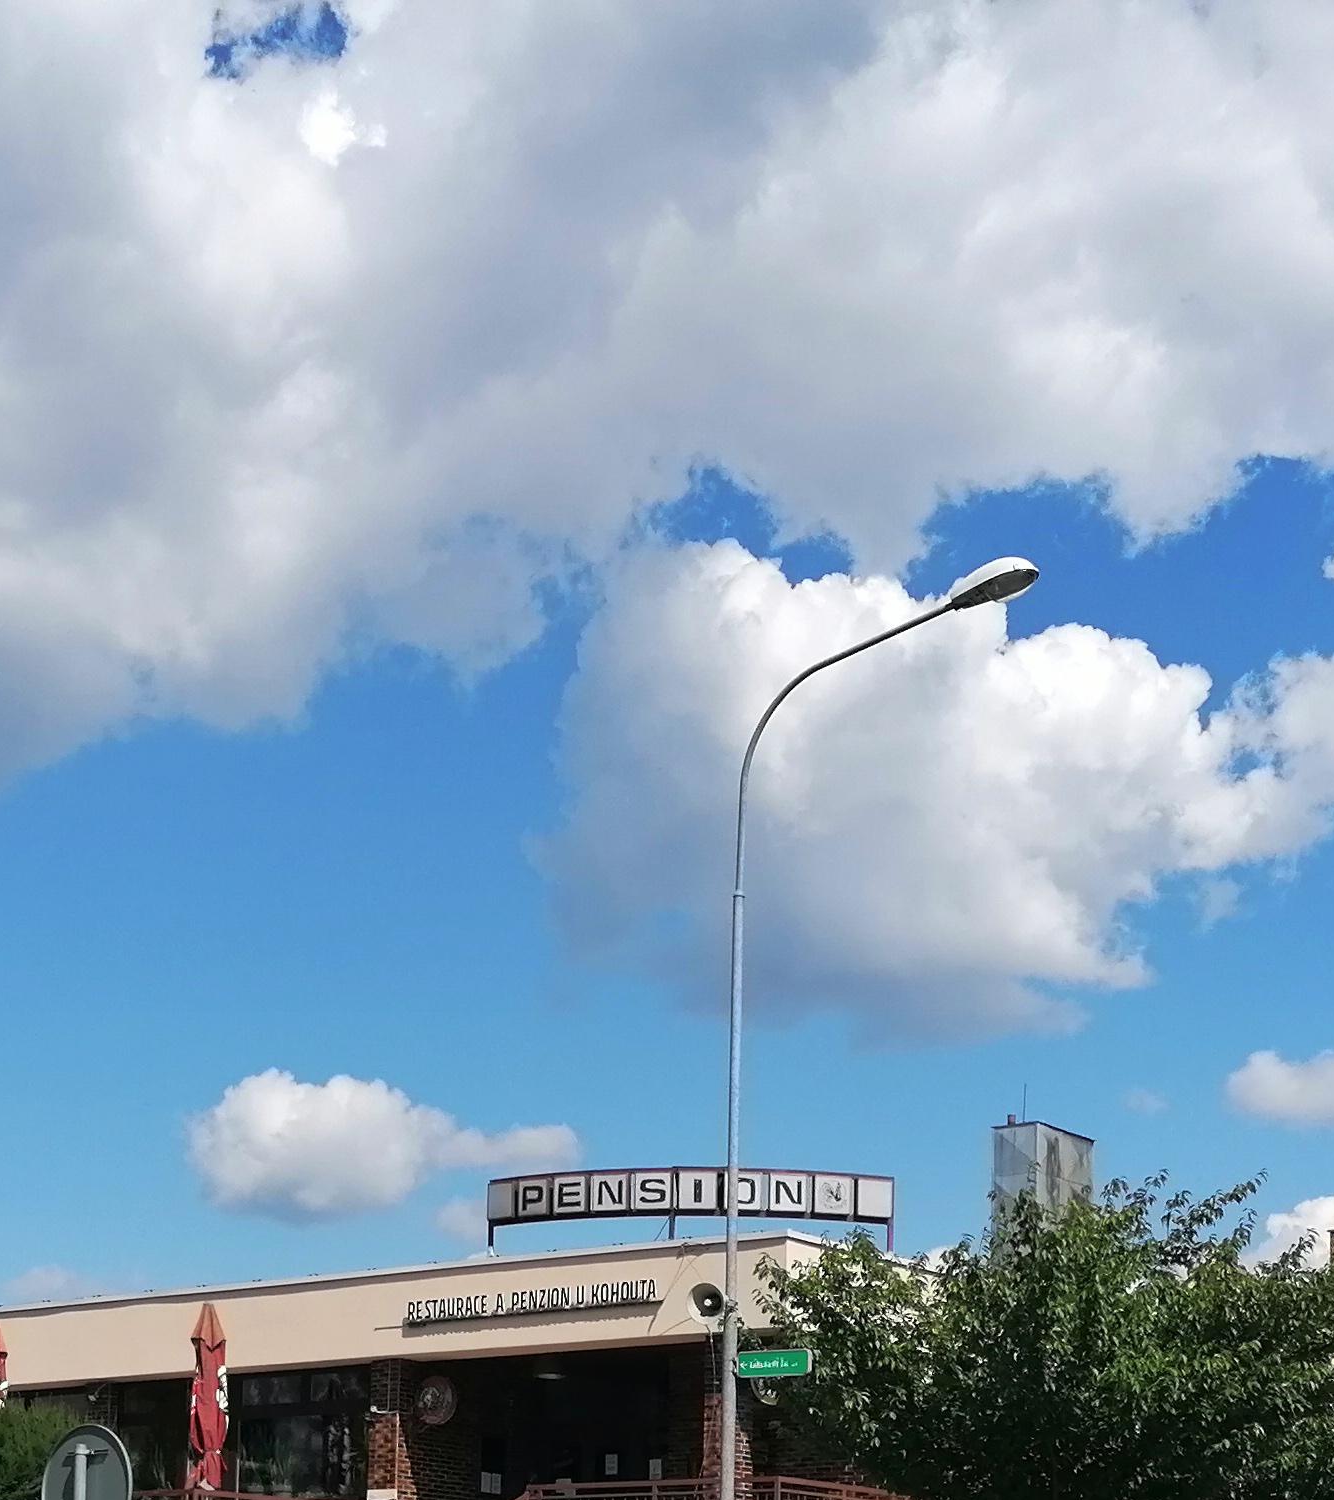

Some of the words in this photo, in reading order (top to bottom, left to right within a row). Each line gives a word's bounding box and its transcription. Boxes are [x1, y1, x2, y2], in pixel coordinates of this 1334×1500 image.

[521, 1178, 803, 1211] PENSION
[407, 1294, 488, 1320] RESTAURACE
[495, 1293, 505, 1312] A
[511, 1286, 568, 1310] PENZION
[576, 1285, 585, 1304] U
[591, 1279, 656, 1304] KOHOUTA
